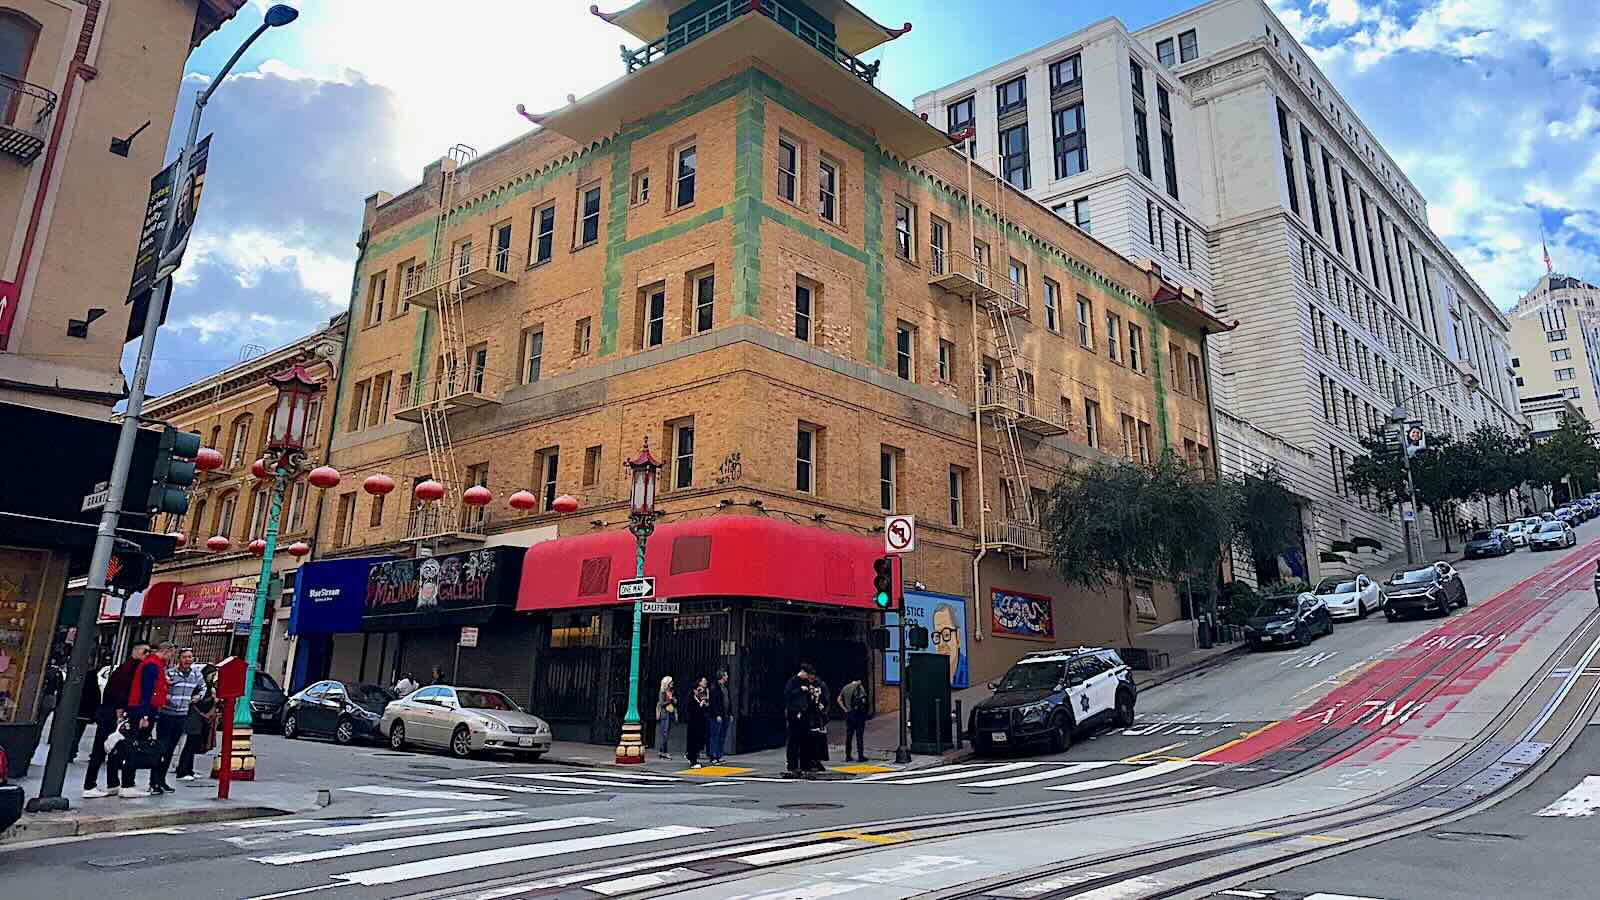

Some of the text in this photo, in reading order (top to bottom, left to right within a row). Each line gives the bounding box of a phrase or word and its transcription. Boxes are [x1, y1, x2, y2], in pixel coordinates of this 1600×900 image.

[439, 574, 488, 600] GALLERY
[621, 583, 643, 594] ONE WAY
[643, 603, 679, 612] CALIFORNIA
